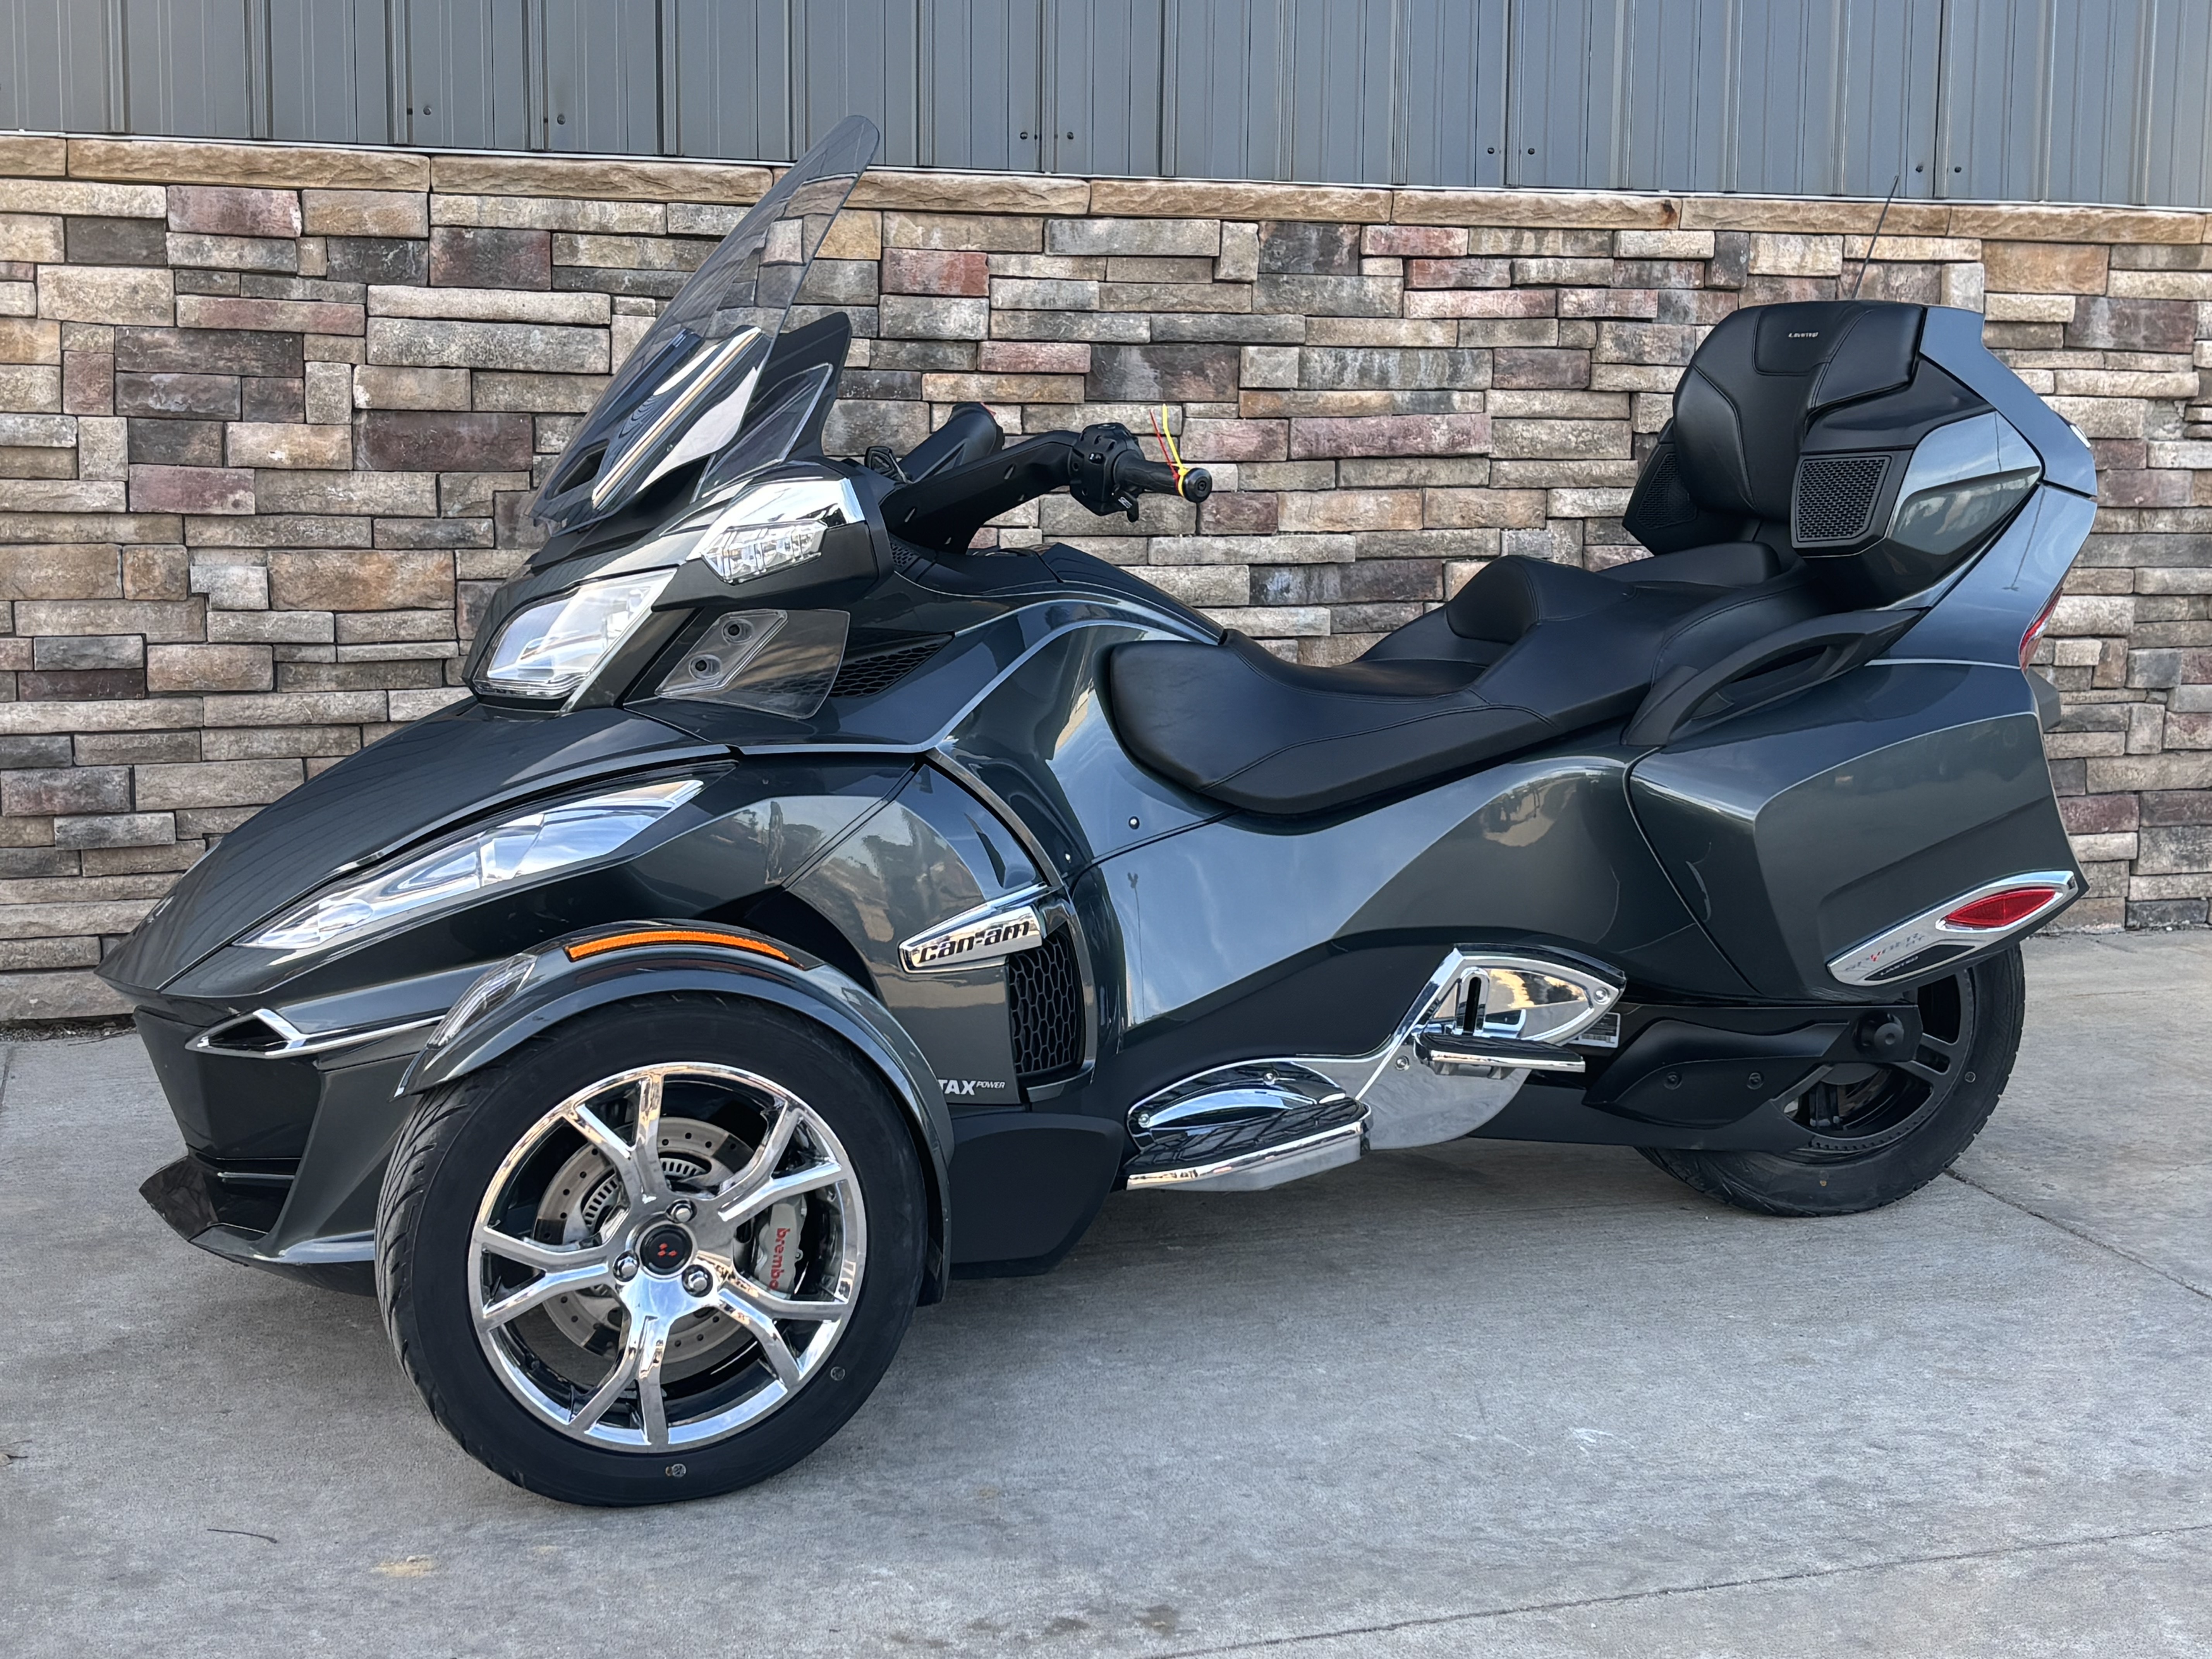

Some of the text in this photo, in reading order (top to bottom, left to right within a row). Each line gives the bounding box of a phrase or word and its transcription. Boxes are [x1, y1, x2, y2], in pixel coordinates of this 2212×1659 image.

[917, 921, 1030, 963] can-am
[976, 1081, 1005, 1089] POWER
[769, 1228, 791, 1290] brembo
